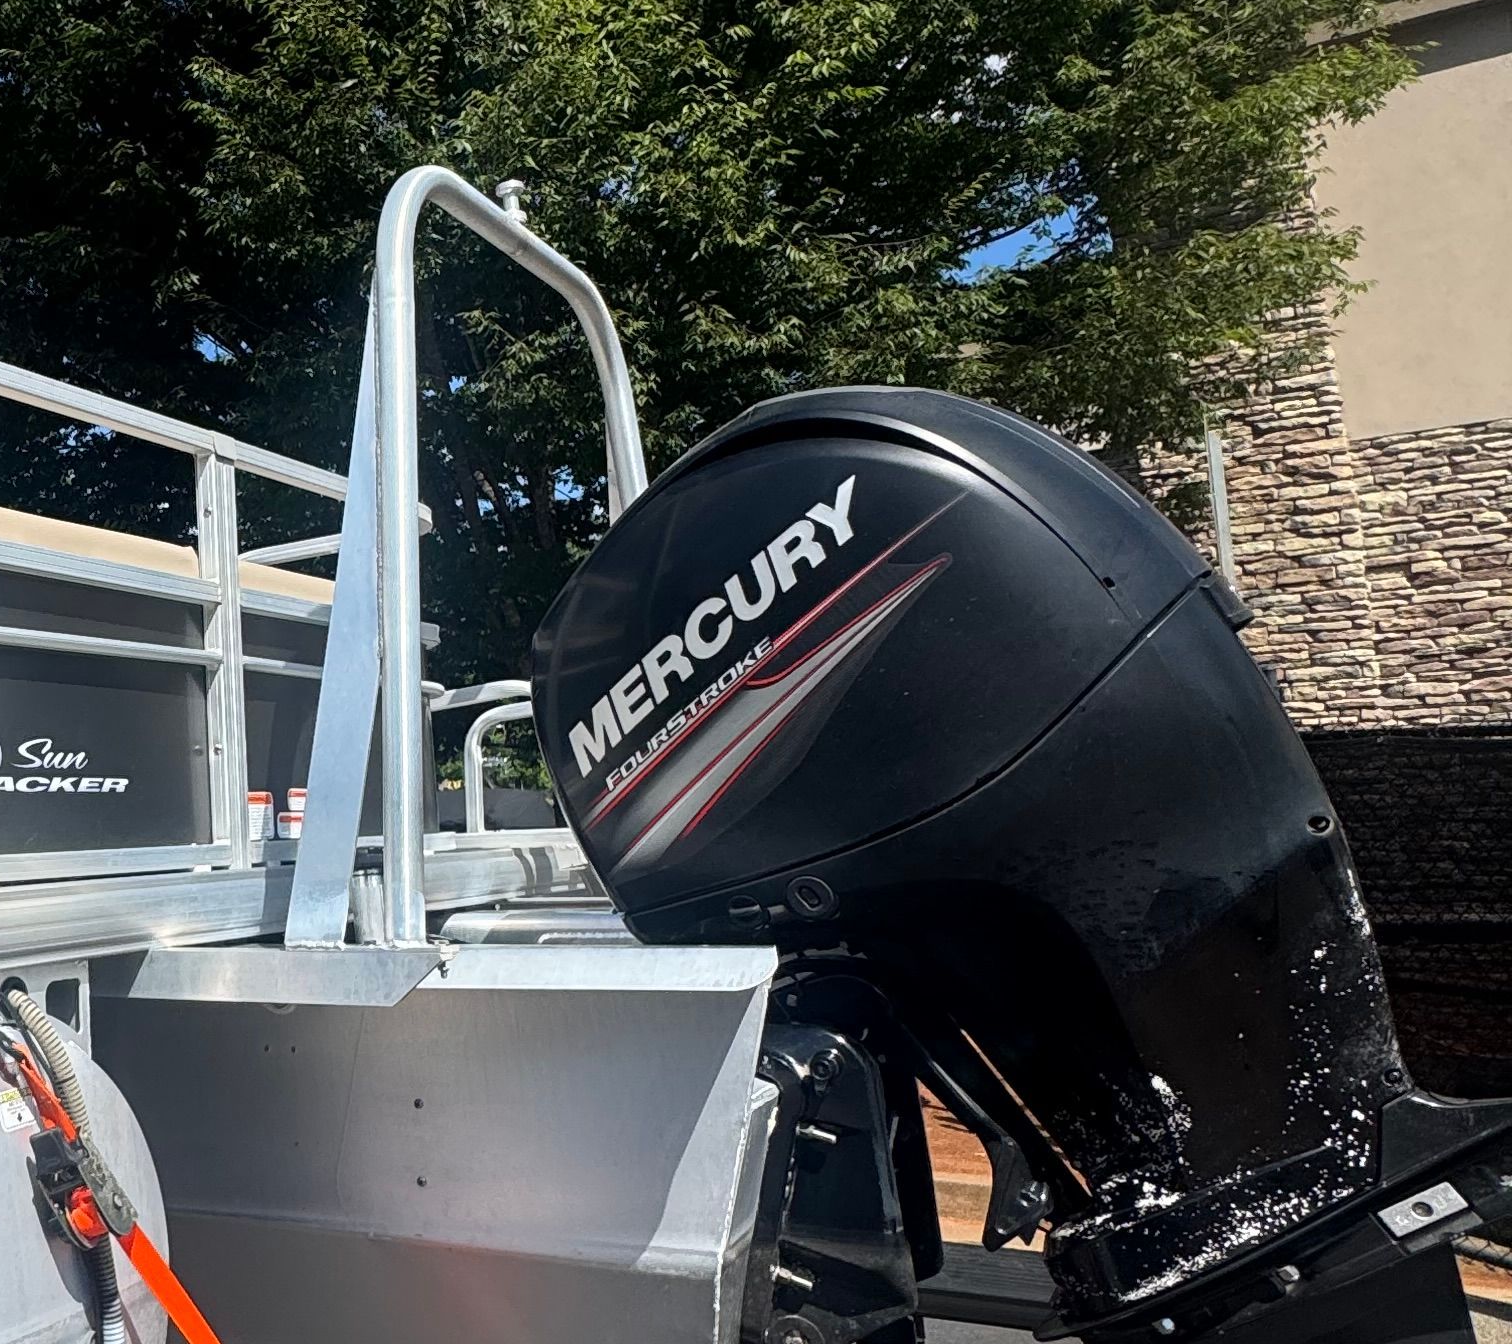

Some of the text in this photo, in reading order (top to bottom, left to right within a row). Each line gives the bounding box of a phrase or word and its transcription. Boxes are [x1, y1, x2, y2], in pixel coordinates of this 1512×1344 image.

[567, 473, 857, 778] MERCURY
[11, 737, 89, 771] Sun
[605, 635, 776, 792] FOURSTROKE
